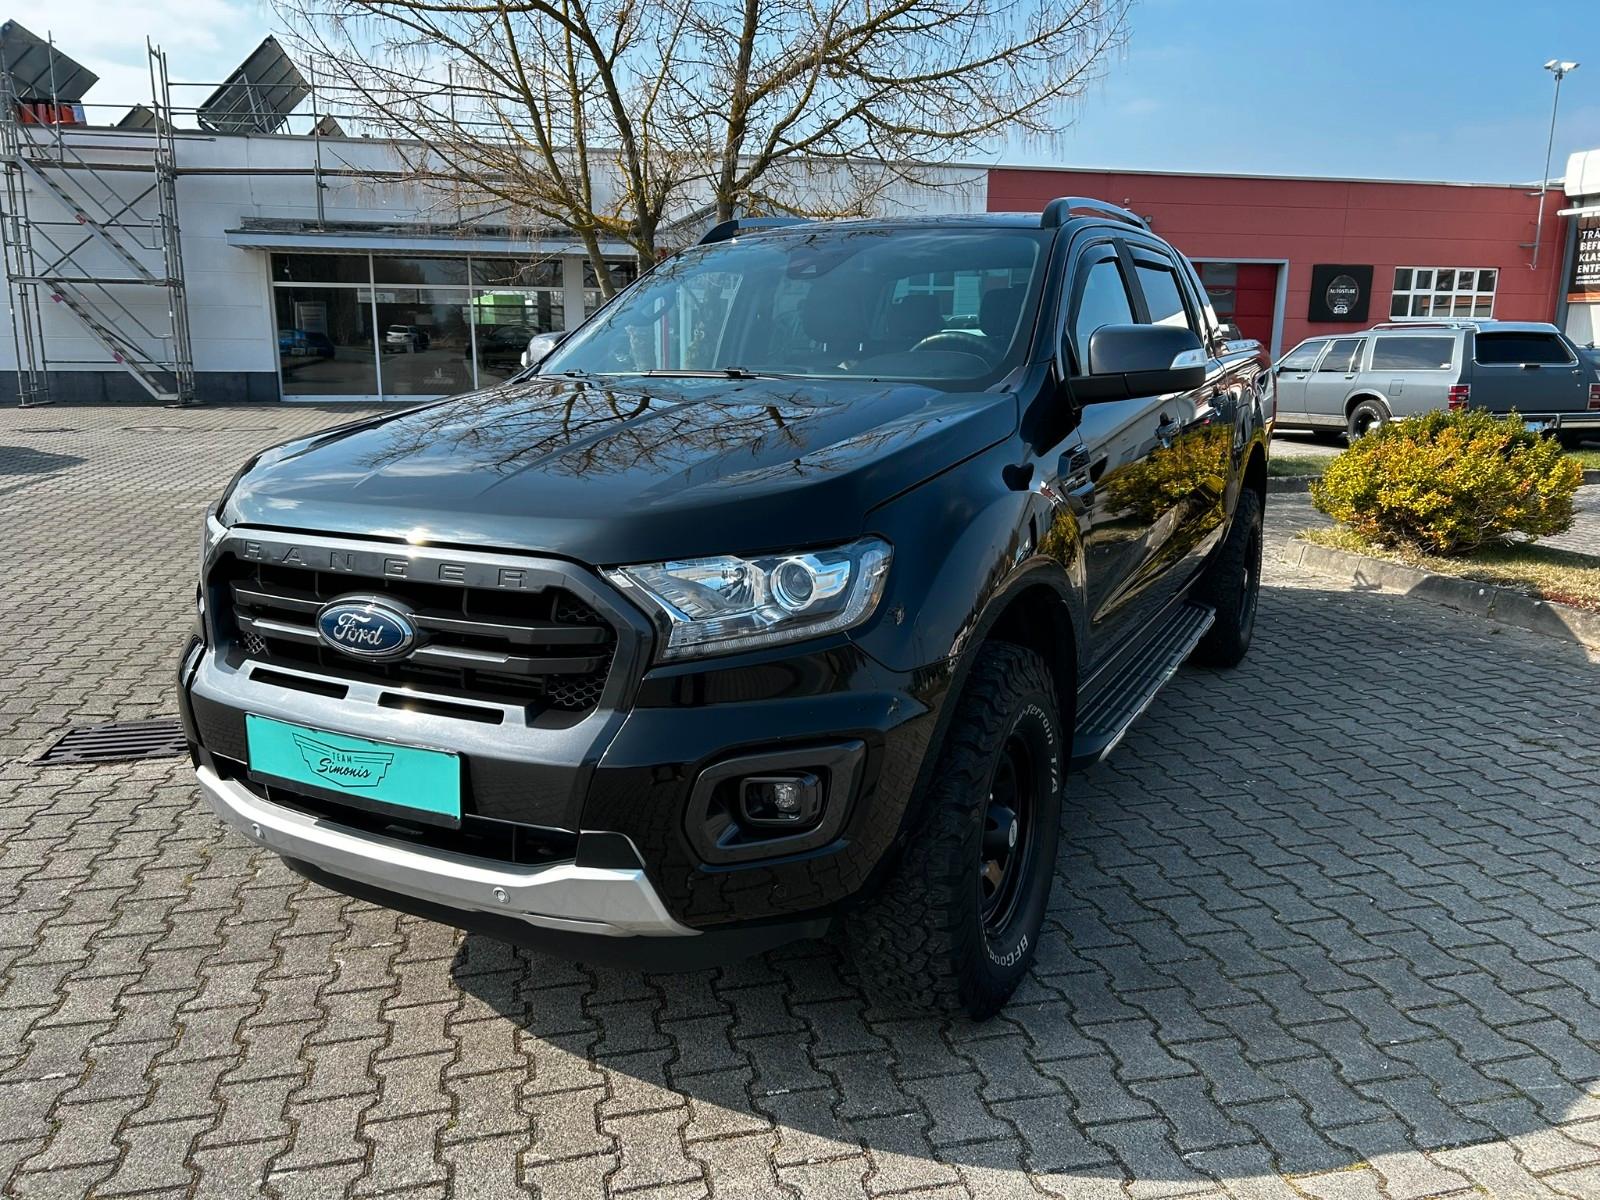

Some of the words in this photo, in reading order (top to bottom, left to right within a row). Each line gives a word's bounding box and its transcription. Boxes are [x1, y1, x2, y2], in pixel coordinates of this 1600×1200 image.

[245, 540, 528, 589] RANGER
[333, 613, 383, 646] Ford
[316, 757, 372, 779] Simonis
[332, 751, 353, 763] TEAM
